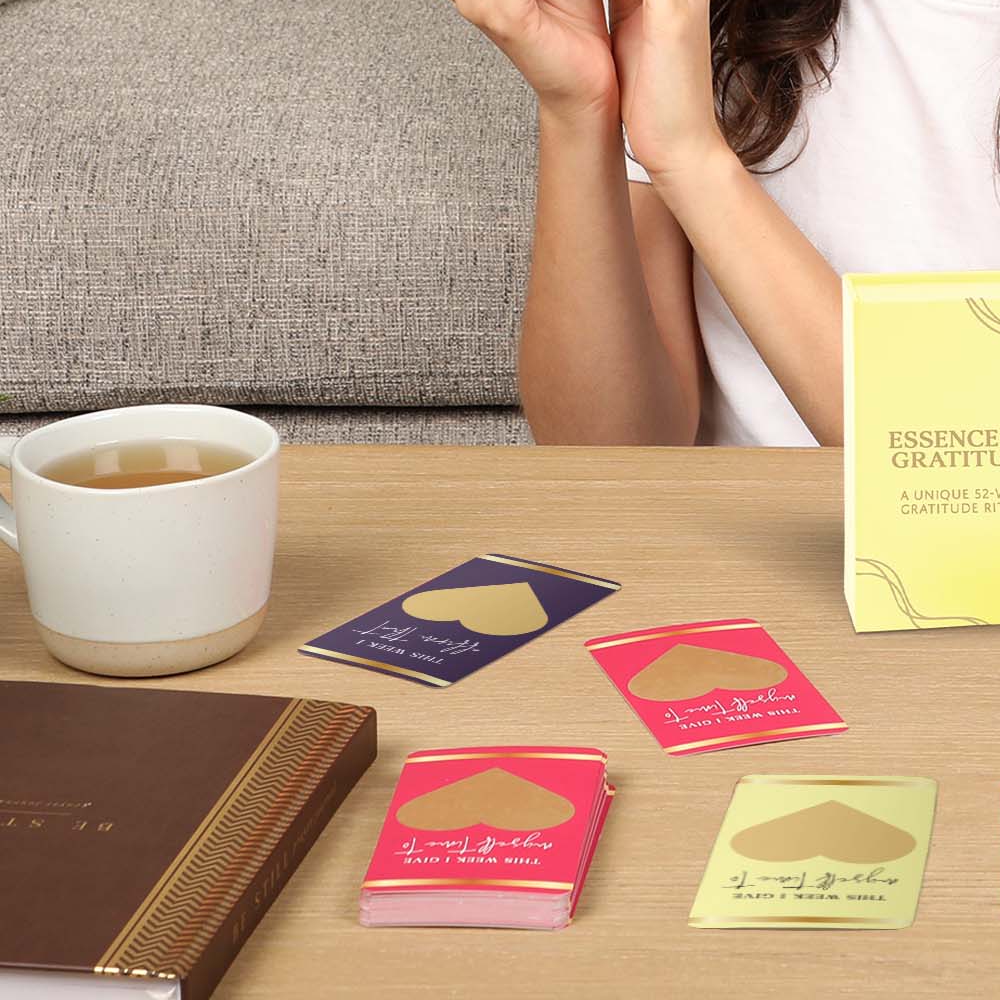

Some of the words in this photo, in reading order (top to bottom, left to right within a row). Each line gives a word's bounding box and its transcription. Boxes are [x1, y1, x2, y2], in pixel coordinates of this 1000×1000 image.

[888, 430, 999, 449] ESSENCE
[900, 490, 909, 501] A
[914, 488, 969, 501] UNIQUE
[901, 503, 979, 515] GRATITUDE
[366, 641, 406, 656] WEEK
[409, 652, 445, 665] THIS
[725, 712, 763, 723] WEEK
[767, 708, 800, 718] THIS
[679, 719, 712, 731] GIVE
[402, 857, 441, 866] GIVE
[456, 856, 498, 865] WEEK
[504, 857, 542, 865] THIS
[793, 893, 841, 901] WEEK
